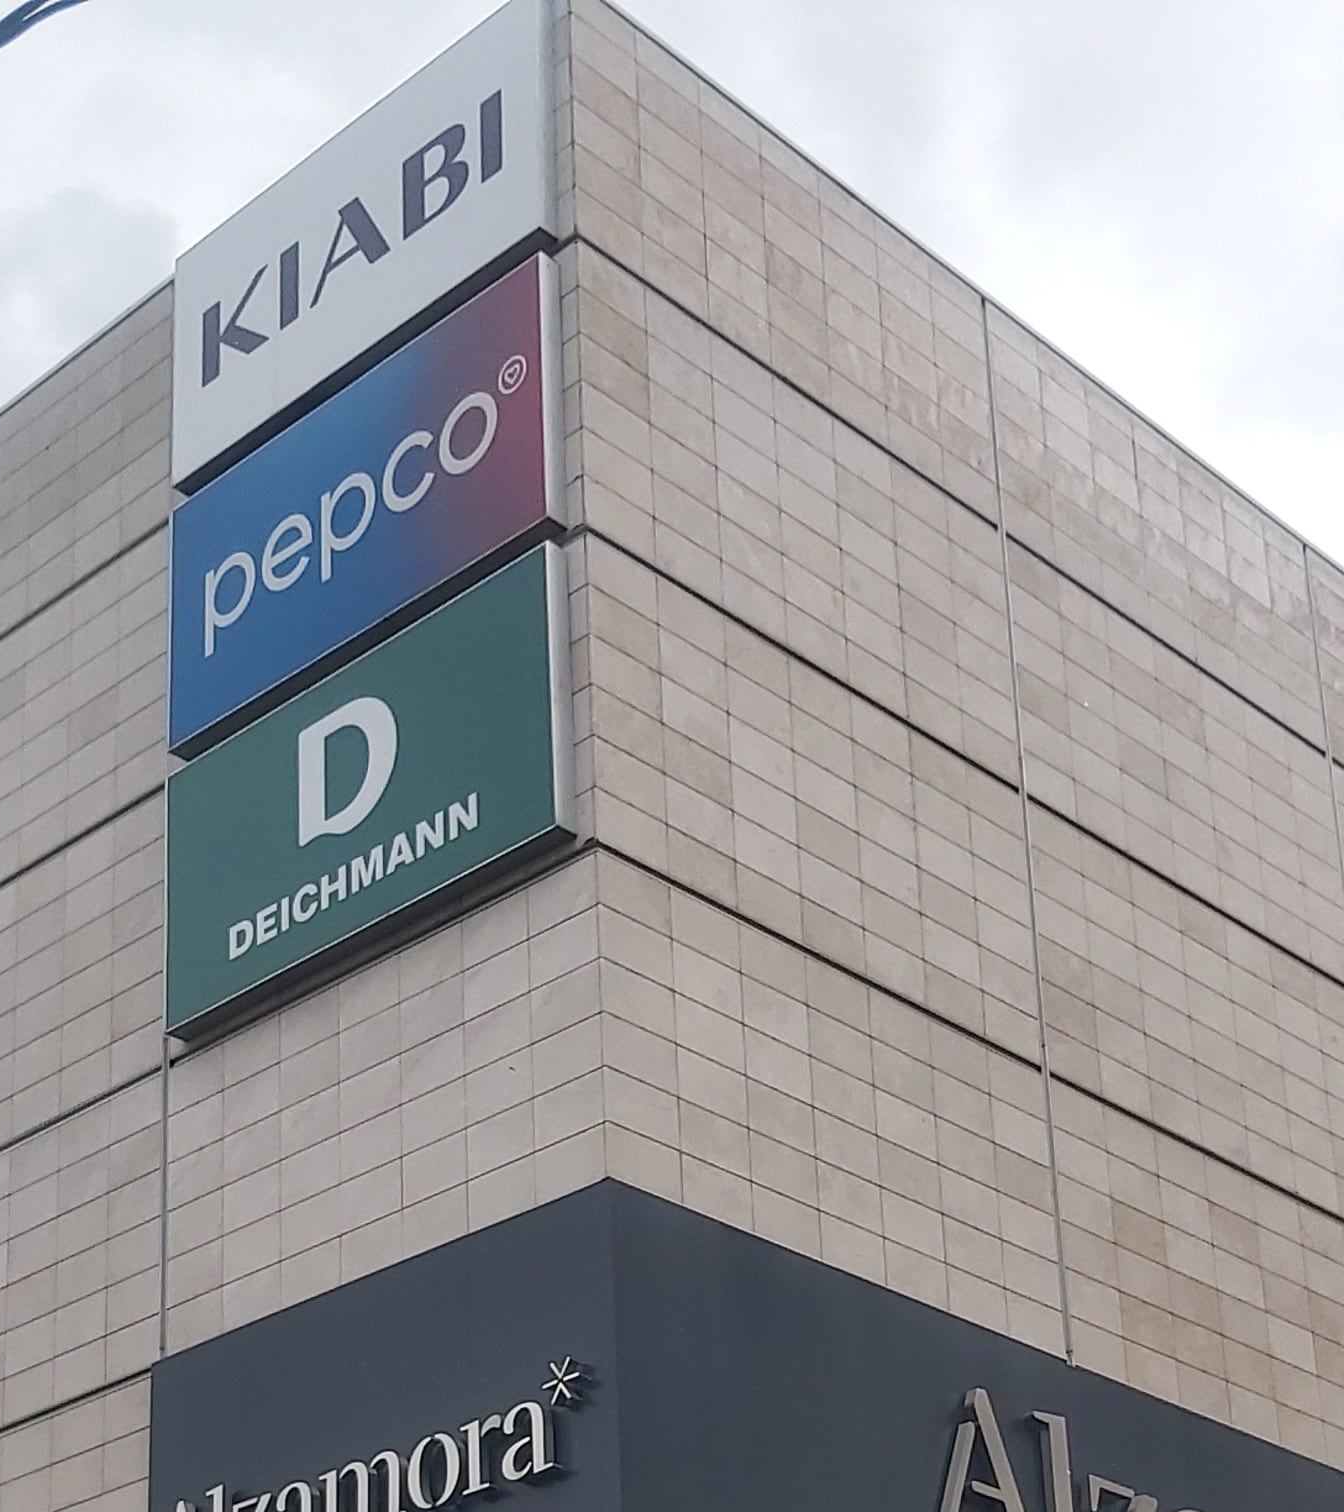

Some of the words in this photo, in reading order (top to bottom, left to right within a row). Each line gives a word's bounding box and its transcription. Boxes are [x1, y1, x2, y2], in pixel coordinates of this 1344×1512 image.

[202, 88, 503, 388] KIABI
[204, 391, 499, 658] pepco
[228, 792, 480, 961] DEICHMANN
[298, 696, 398, 848] D
